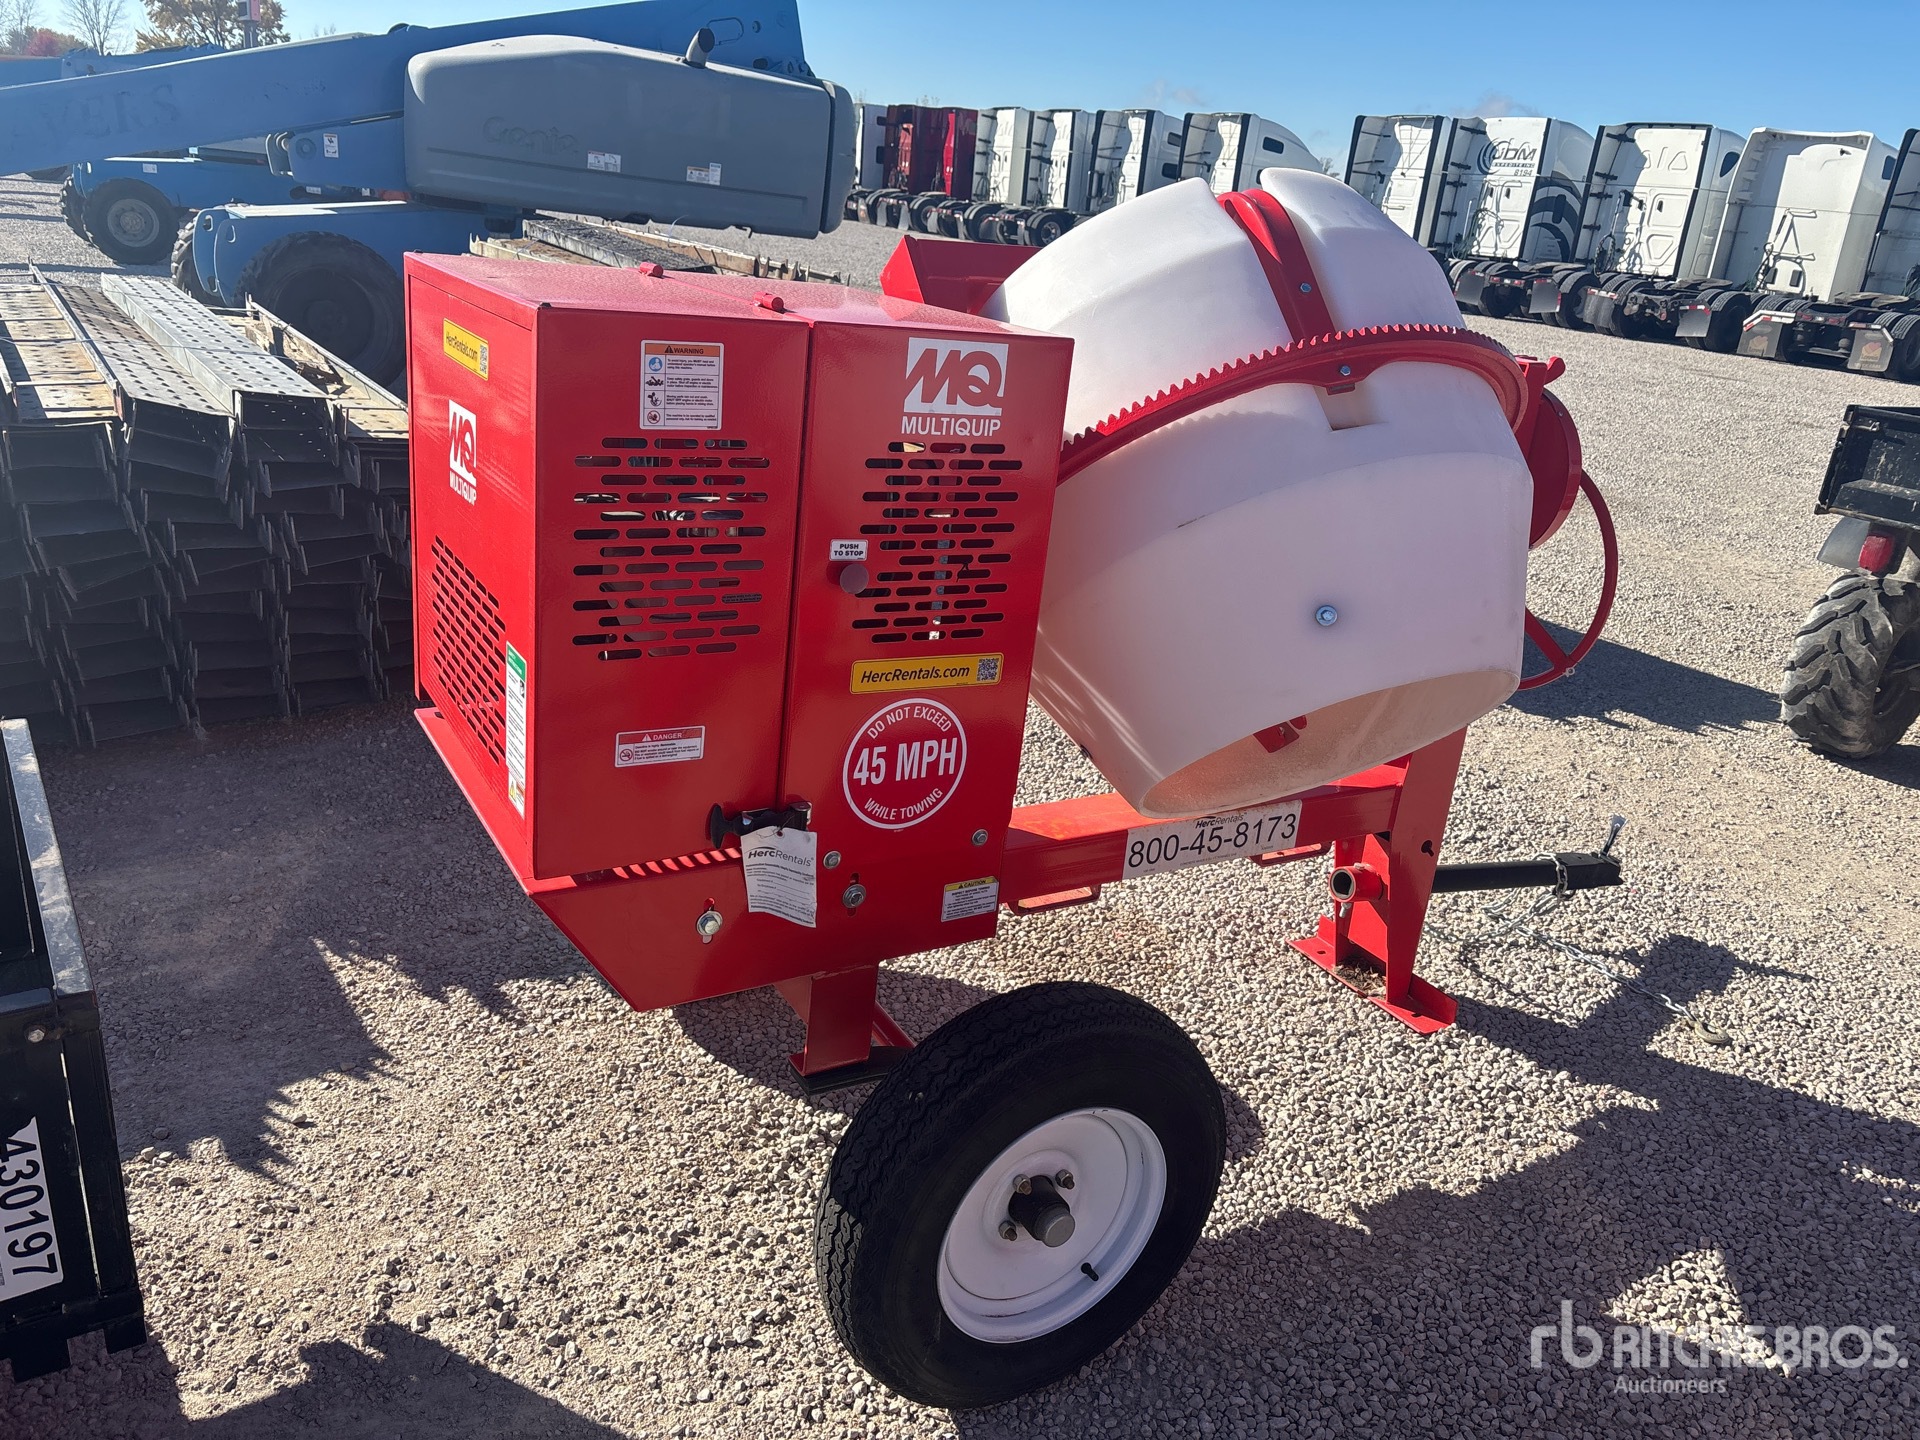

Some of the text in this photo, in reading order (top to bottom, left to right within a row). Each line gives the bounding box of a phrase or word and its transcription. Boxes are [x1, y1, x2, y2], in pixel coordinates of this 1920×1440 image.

[673, 347, 704, 355] WARNING
[904, 346, 1005, 410] MQ
[901, 415, 1001, 437] MULTIQUIP
[448, 409, 478, 477] MQ
[449, 470, 478, 506] MULTIQUIP
[860, 666, 970, 684] HercRentals.com
[652, 732, 682, 741] DANGER
[867, 705, 952, 739] DO NOT EXCEED
[853, 737, 958, 786] 45 MPH
[864, 787, 944, 820] WHILE TOWING
[1128, 812, 1297, 868] 800-45-8173
[963, 879, 987, 888] CAUTION
